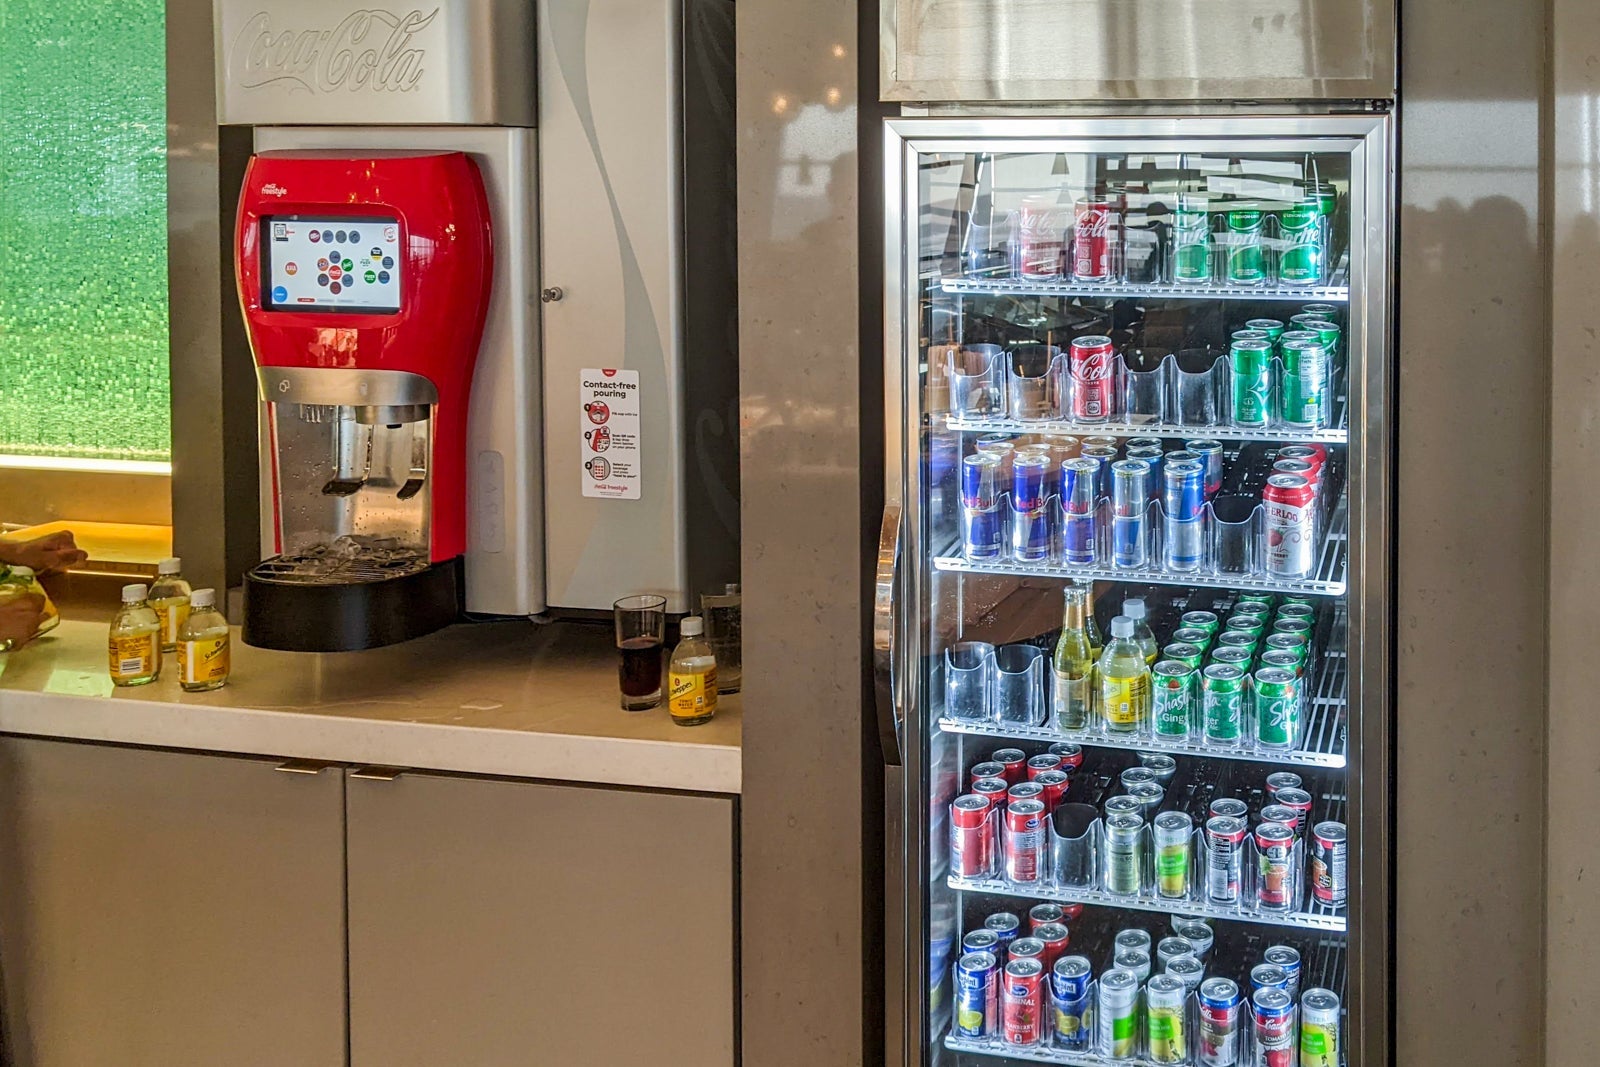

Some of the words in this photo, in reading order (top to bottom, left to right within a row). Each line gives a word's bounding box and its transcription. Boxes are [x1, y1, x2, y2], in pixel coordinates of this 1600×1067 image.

[228, 7, 439, 96] Coca-Cola
[583, 381, 636, 389] Contact-free
[593, 390, 626, 399] pouring
[1161, 713, 1185, 726] Ging
